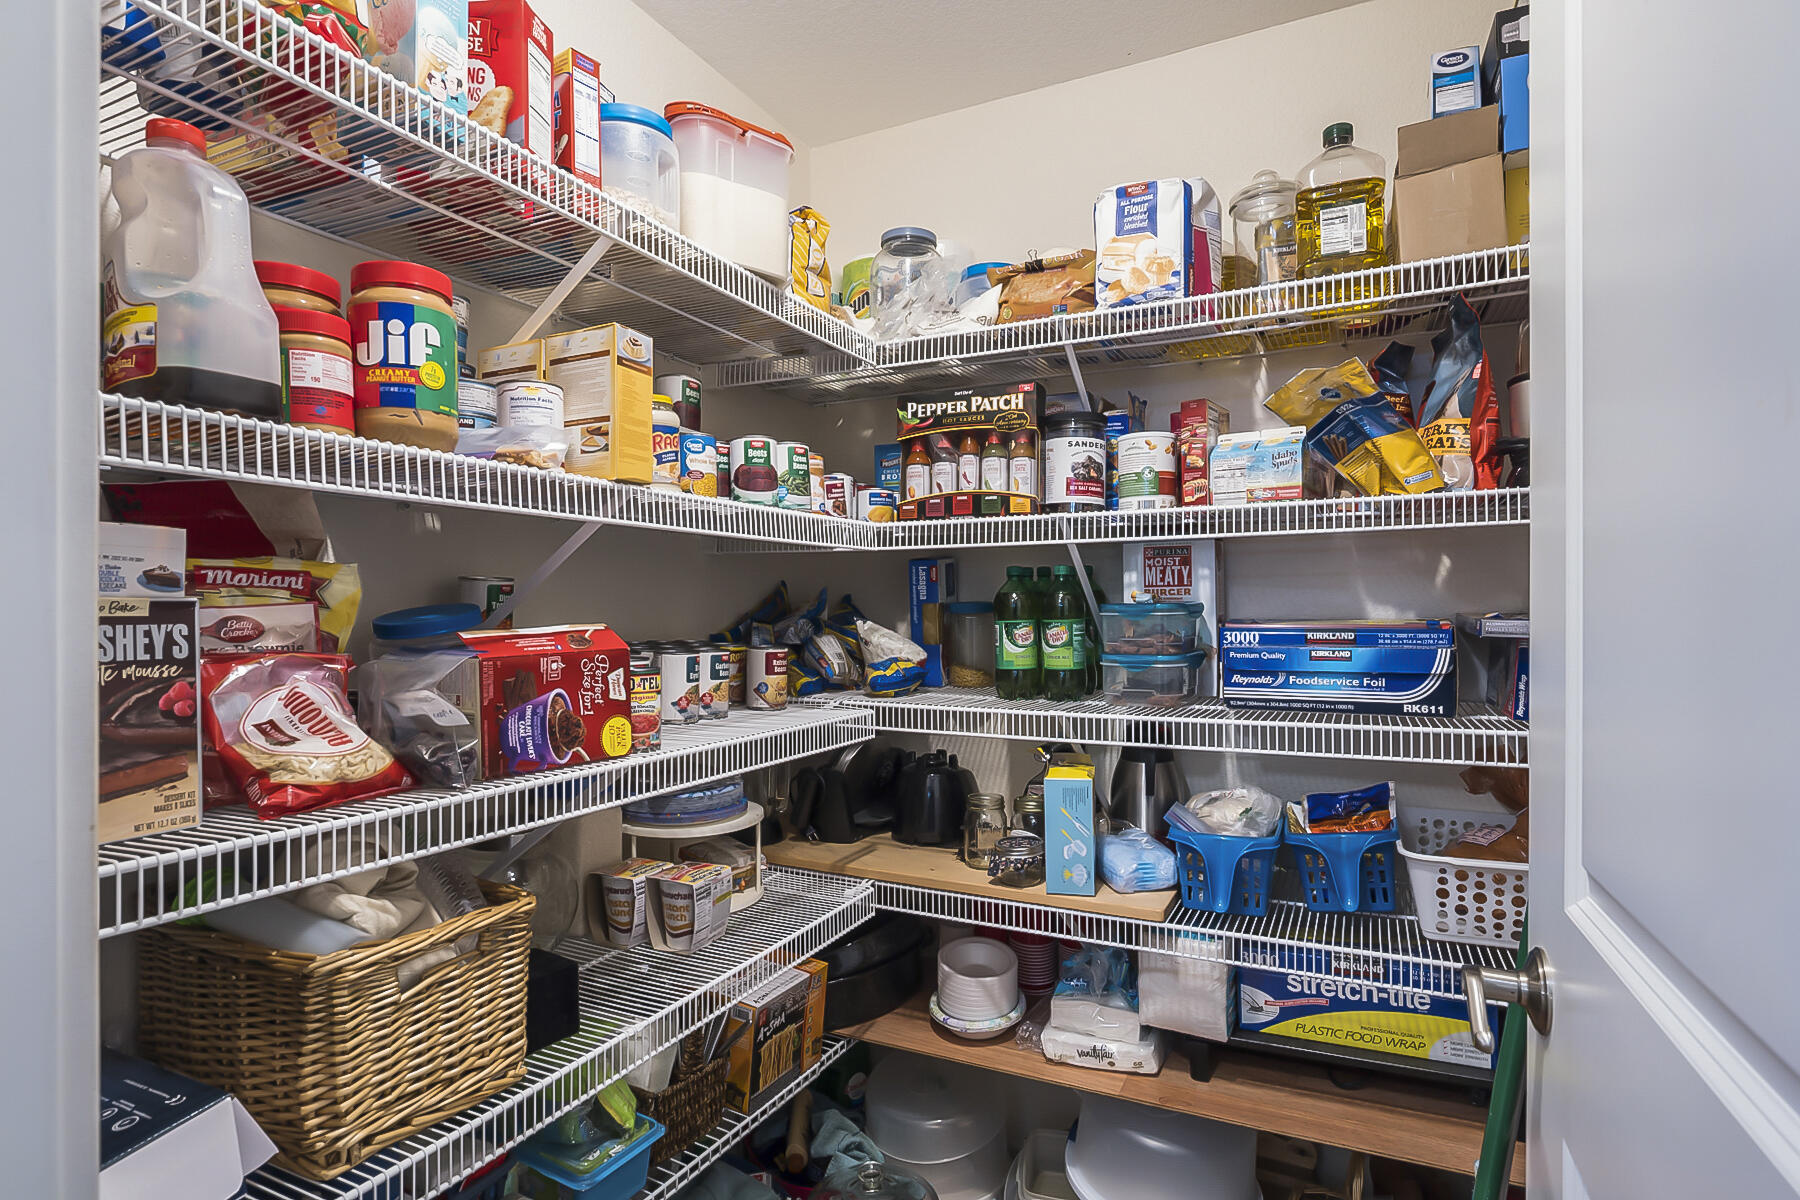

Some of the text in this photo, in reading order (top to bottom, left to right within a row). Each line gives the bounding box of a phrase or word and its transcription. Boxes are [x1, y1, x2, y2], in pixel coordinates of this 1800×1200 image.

[1131, 193, 1154, 204] PURPOSE
[1124, 203, 1148, 216] Flour
[356, 319, 441, 366] Jif
[368, 368, 411, 377] CREAMY
[907, 392, 1025, 418] PEPPER PATCH
[747, 448, 768, 458] Beets
[1271, 449, 1298, 461] Idaho
[1271, 456, 1298, 469] Spuds
[1154, 548, 1188, 556] PURINA
[1145, 557, 1181, 567] MOIST
[201, 569, 304, 589] Mariani
[1145, 566, 1190, 586] MEATY
[918, 566, 928, 600] Lasagna
[108, 600, 139, 615] Bake
[227, 619, 253, 630] Betty
[1222, 631, 1260, 644] 3000
[1307, 632, 1355, 640] KIRKLAND
[1260, 651, 1286, 661] Quality
[122, 664, 184, 681] Mousse
[581, 658, 596, 689] Size
[594, 654, 610, 705] Perfect
[1231, 674, 1386, 688] Reynolds Foodservice Foil
[581, 688, 594, 709] for
[277, 685, 355, 747] ALMONDS
[1403, 704, 1444, 715] RK611
[153, 803, 173, 813] MAKES
[133, 823, 145, 832] NET
[1295, 1022, 1427, 1052] PLASTIC FOOD WRAP
[1360, 1025, 1425, 1040] PROFESSIONAL QUALITY
